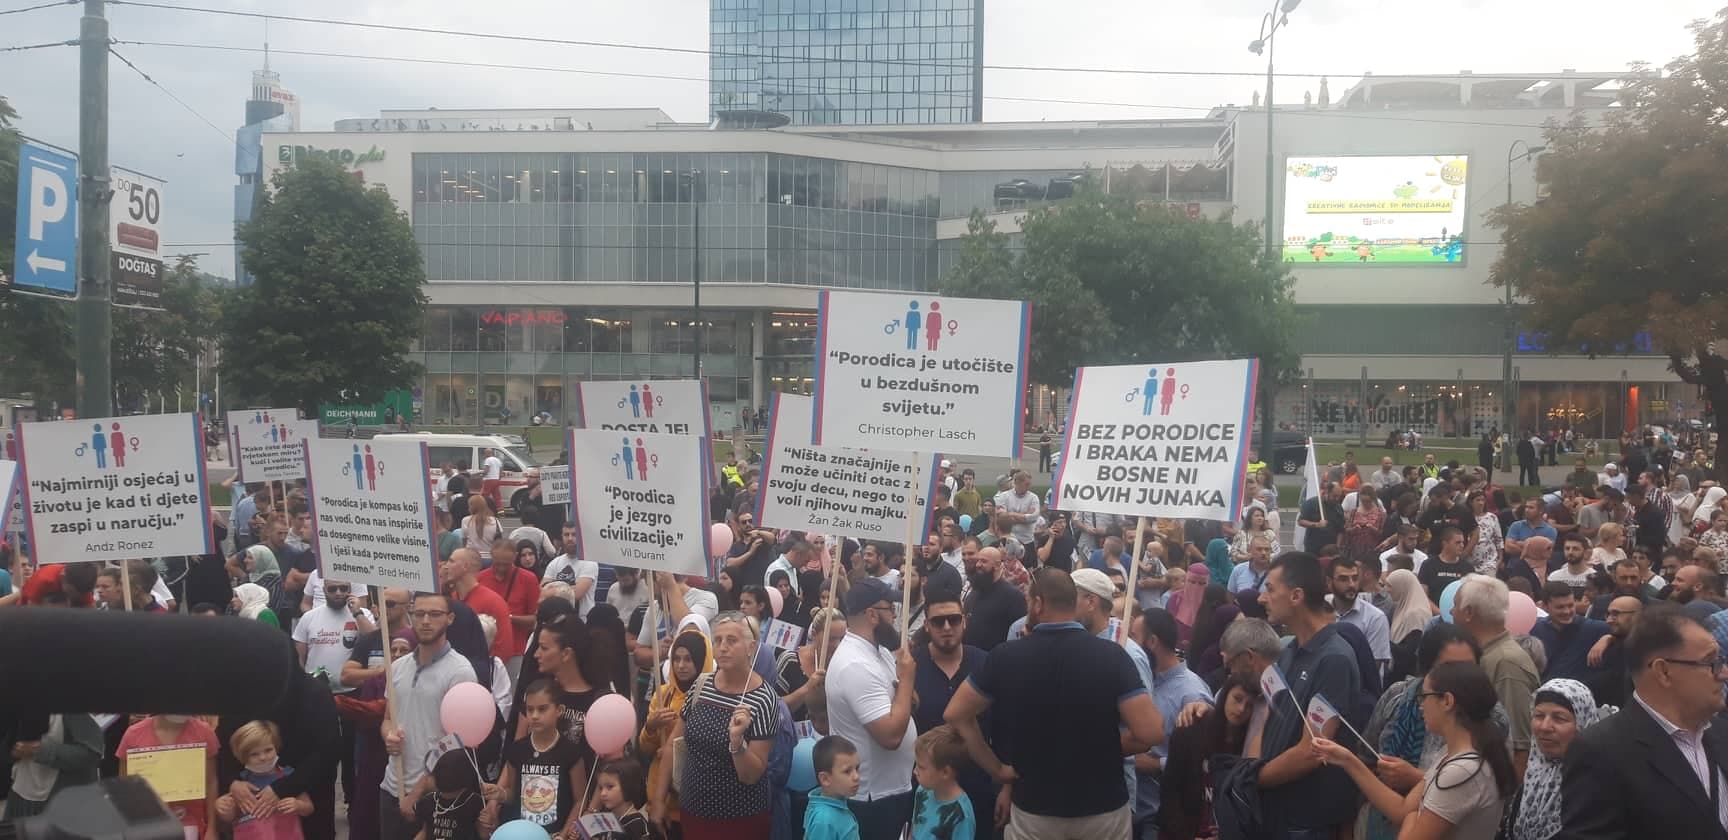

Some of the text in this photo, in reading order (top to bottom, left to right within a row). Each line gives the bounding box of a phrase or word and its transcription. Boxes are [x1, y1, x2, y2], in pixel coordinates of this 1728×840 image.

[29, 166, 68, 241] P
[118, 179, 160, 225] DO 50
[830, 350, 1014, 373] “Porodica je utočište
[860, 375, 979, 394] u bezdušnom
[882, 399, 955, 416] svijetu.”
[858, 423, 976, 440] Christopher Lasch
[1077, 423, 1235, 441] BEZ PORODICE
[784, 446, 826, 463] “Ništa
[830, 454, 900, 474] značajnije
[1075, 444, 1229, 463] I BRAKA NEMA
[31, 470, 195, 494] “Najmirniji osjećaj u
[780, 463, 919, 490] može učiniti otac z
[1096, 465, 1199, 485] BOSNE NI
[604, 485, 675, 505] “Porodica
[769, 478, 807, 492] svoju
[810, 481, 849, 498] decu,
[852, 488, 887, 504] nego
[890, 491, 905, 503] to
[1063, 484, 1226, 508] NOVIH JUNAKA
[33, 498, 82, 514] životu
[86, 497, 101, 513] je
[106, 495, 136, 509] kad
[140, 494, 152, 507] ti
[155, 492, 199, 509] djete
[360, 500, 368, 511] je
[369, 499, 402, 513] kompas
[403, 501, 419, 515] koji
[776, 494, 802, 507] voli
[805, 497, 857, 514] njihovu
[51, 513, 185, 535] zaspi u naručju.”
[320, 514, 423, 530] nas vodi. Ona nas inspiriše
[609, 505, 672, 526] je jezgro
[807, 514, 882, 532] Žan Žak Ruso
[85, 540, 153, 552] Andz Ronez
[319, 529, 430, 549] da dosegnemo velike visine,
[600, 525, 684, 548] civilizacije.”
[334, 544, 351, 557] tješi
[351, 547, 371, 559] kada
[373, 550, 420, 563] povremeno
[621, 547, 665, 561] Vil Durant
[378, 566, 397, 577] Bred
[399, 568, 421, 580] Henri
[521, 763, 560, 775] ALWAYS BE
